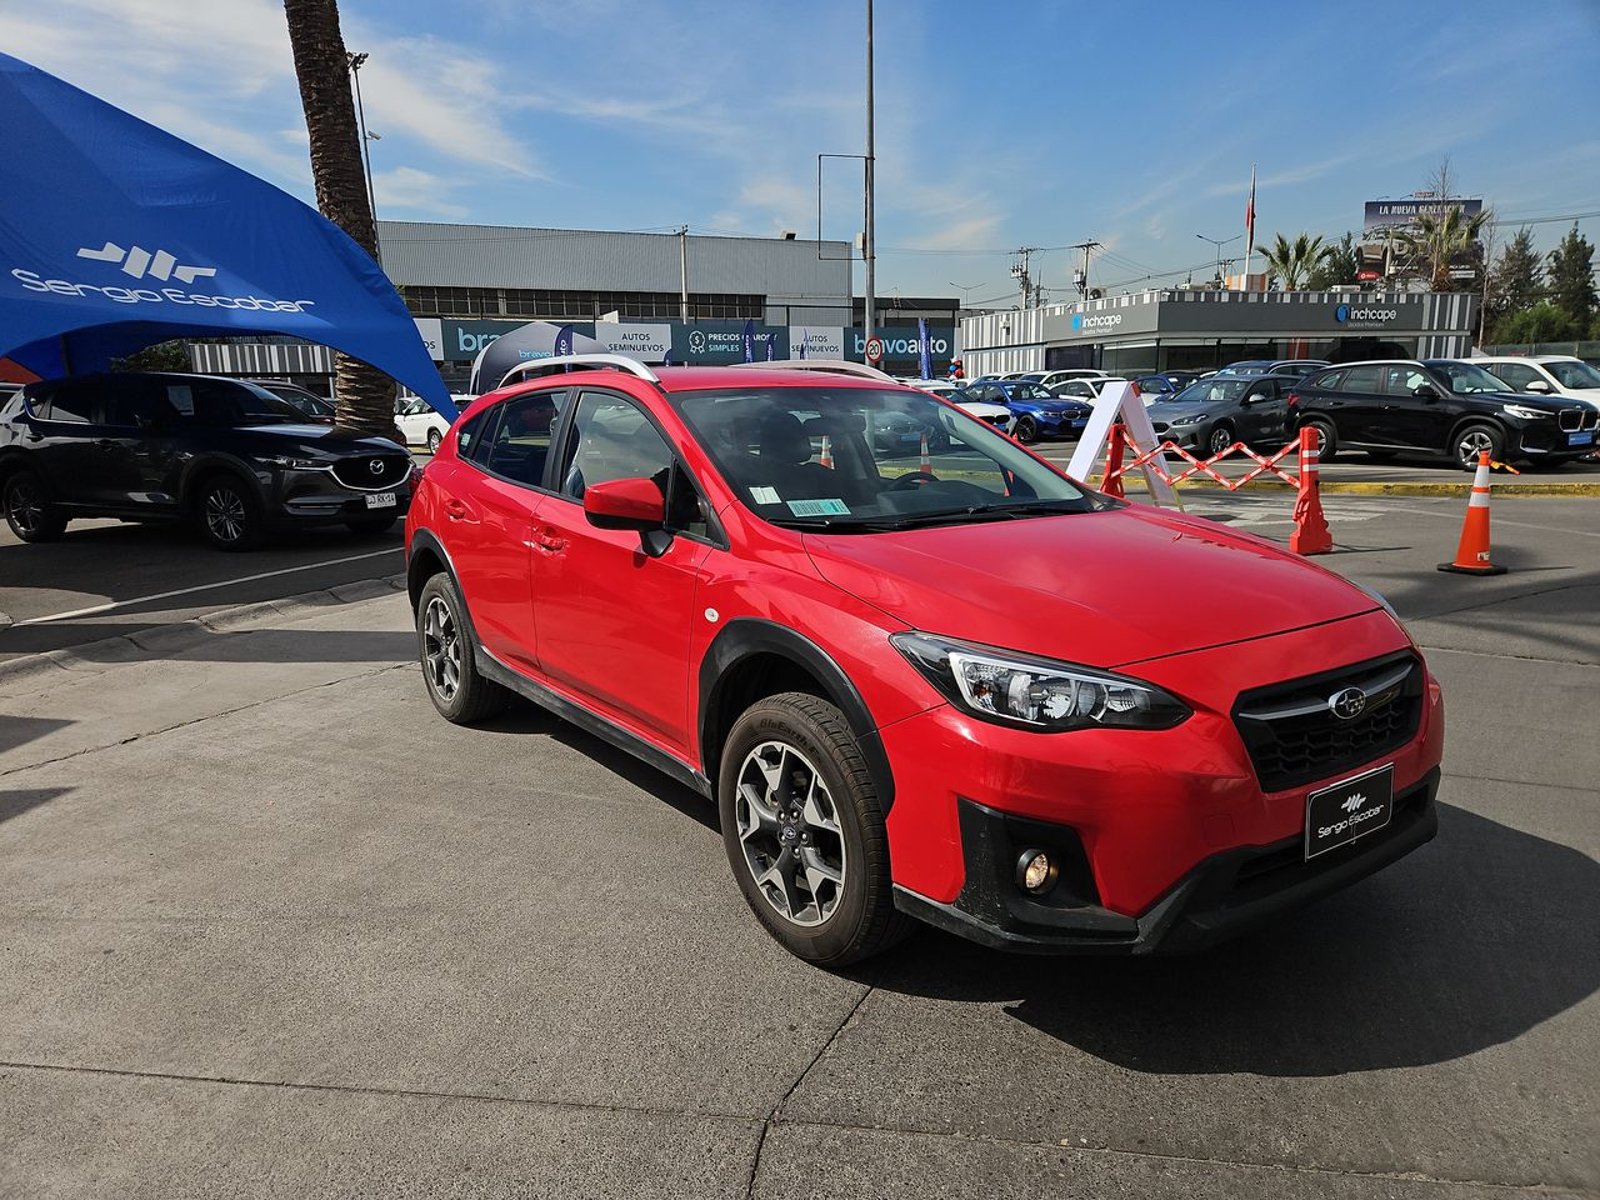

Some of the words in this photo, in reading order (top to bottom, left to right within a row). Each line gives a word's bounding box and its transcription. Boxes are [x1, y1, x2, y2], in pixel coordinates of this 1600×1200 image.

[11, 267, 163, 304] Sergio
[161, 287, 315, 313] Escobar
[1351, 307, 1397, 322] inchcape
[1082, 314, 1122, 328] inchcape
[621, 333, 651, 341] AUTOS
[708, 333, 740, 341] PRECIOS
[608, 343, 665, 352] SEMINUEVOS
[708, 344, 740, 352] SIMPLES
[869, 344, 880, 356] 20
[1348, 804, 1385, 826] Escobar
